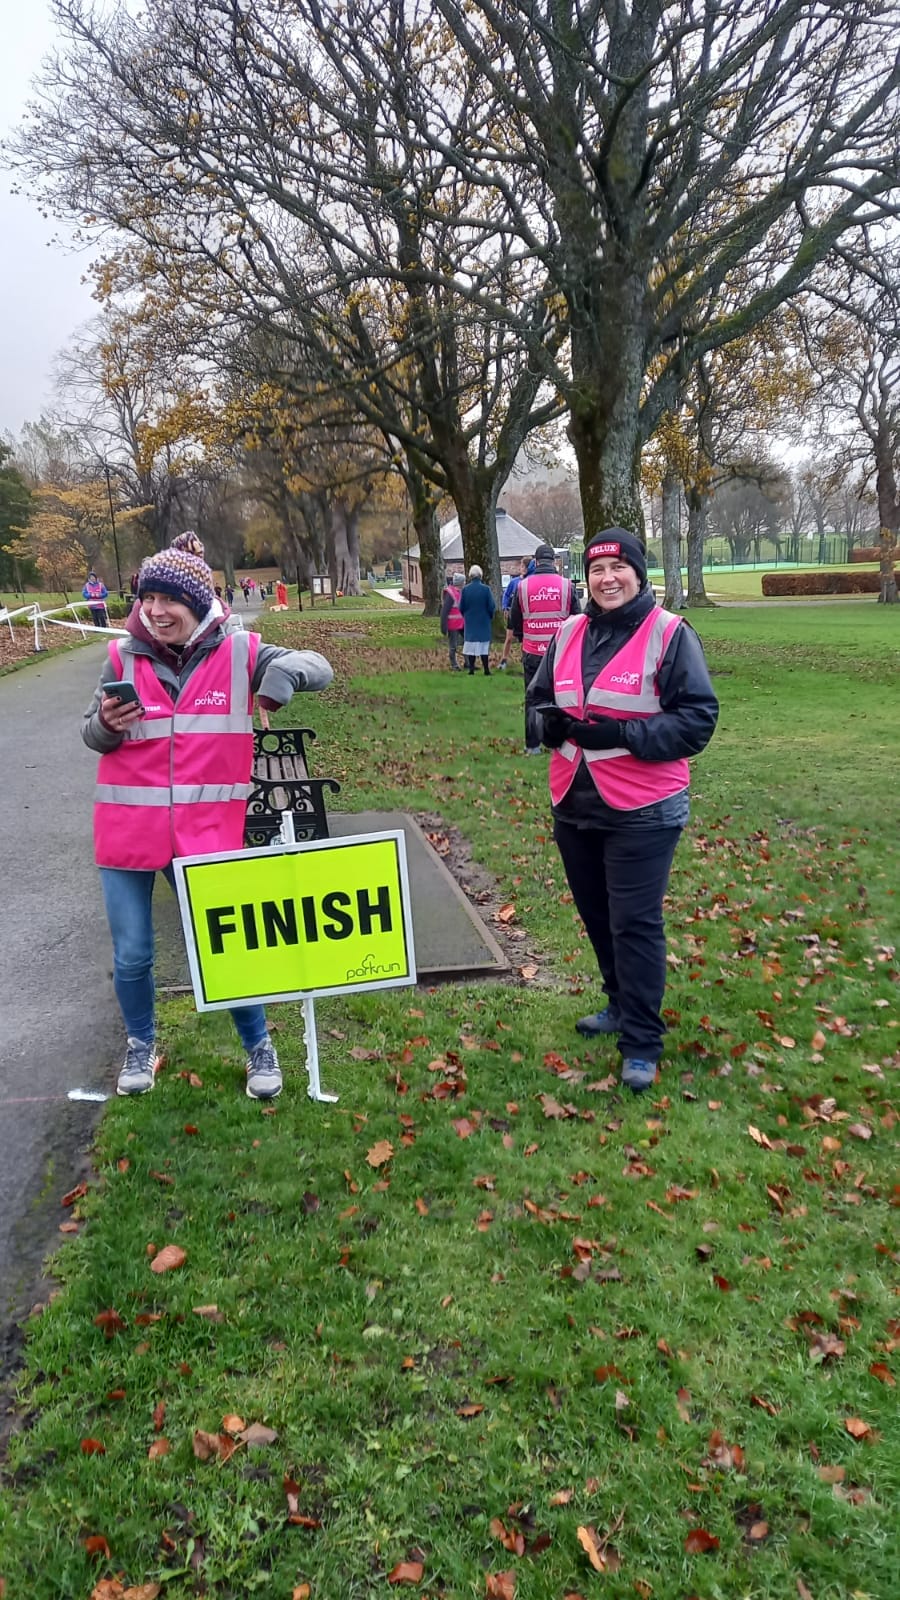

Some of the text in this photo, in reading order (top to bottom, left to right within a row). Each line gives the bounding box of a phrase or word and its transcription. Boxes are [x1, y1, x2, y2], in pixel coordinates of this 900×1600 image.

[590, 544, 616, 555] VELUX
[529, 587, 560, 602] parkrun
[527, 621, 562, 629] VOLUNTEE
[205, 885, 393, 955] FINISH
[346, 954, 400, 981] parkrun
